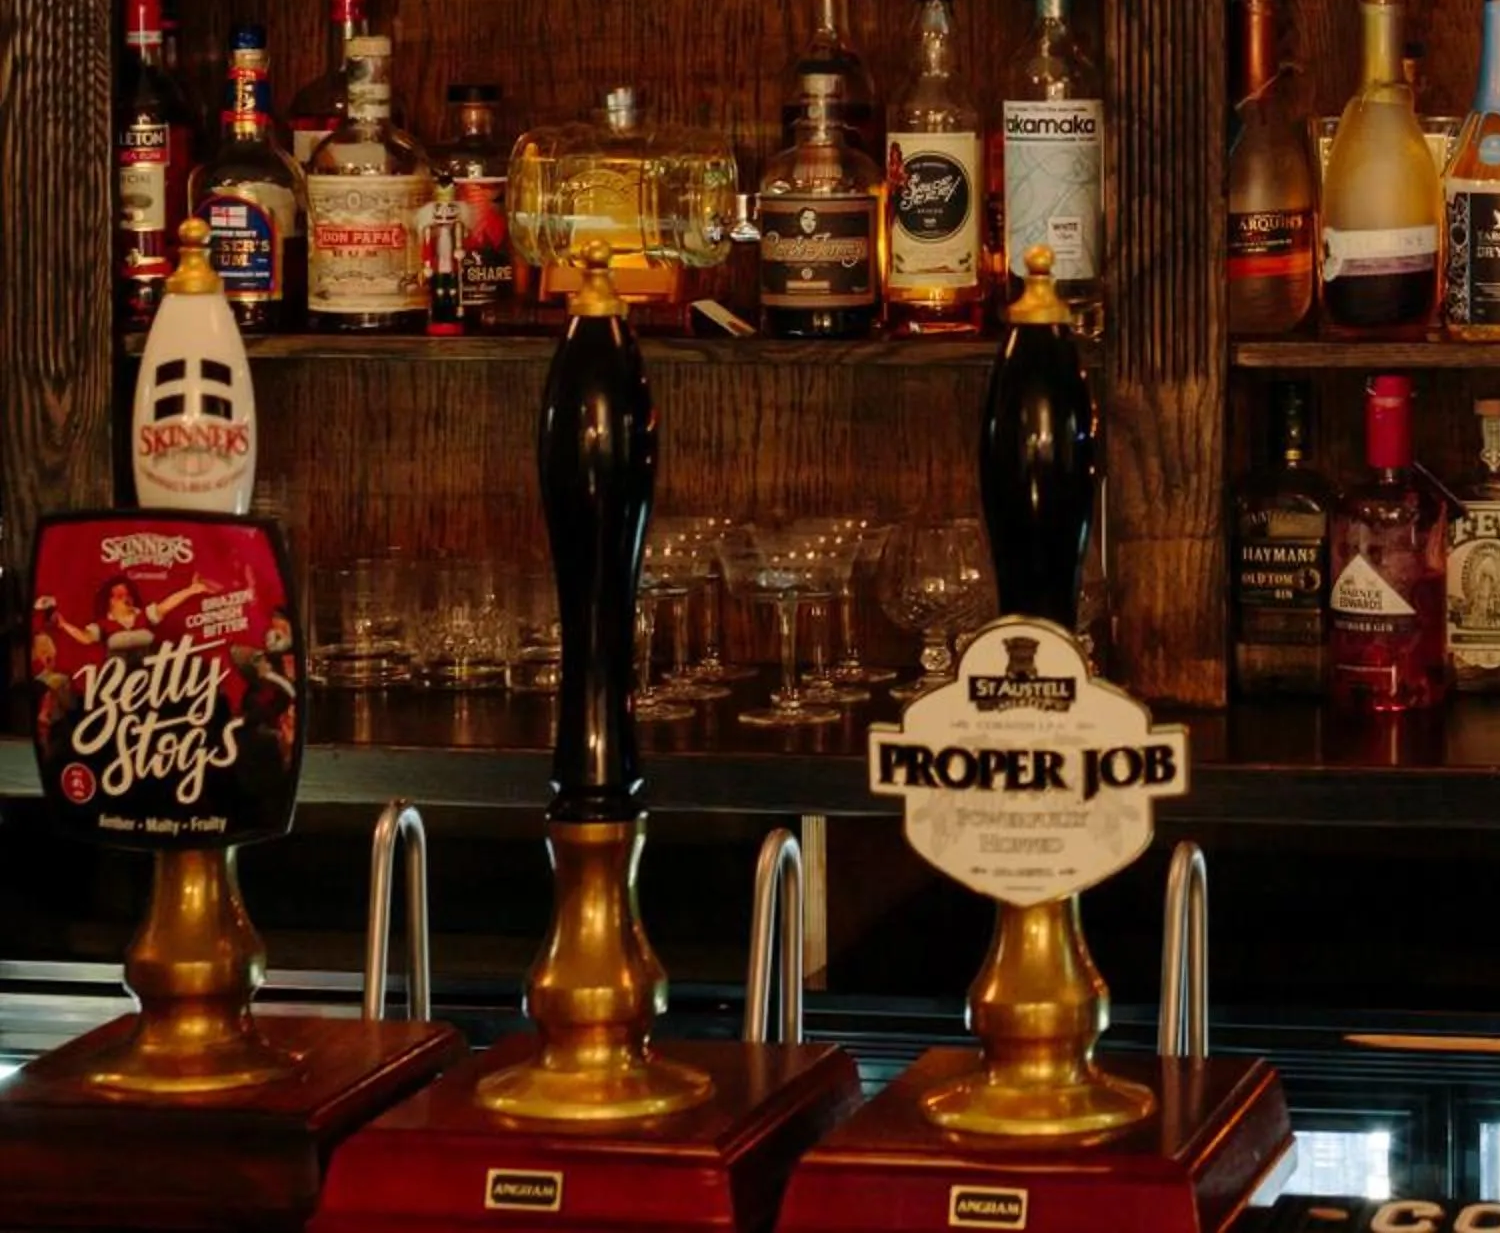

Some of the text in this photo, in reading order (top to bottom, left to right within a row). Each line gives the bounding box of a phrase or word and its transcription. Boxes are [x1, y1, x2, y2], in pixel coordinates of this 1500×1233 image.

[321, 231, 352, 246] DON
[466, 265, 513, 282] SHARE
[71, 634, 231, 755] Betty
[101, 711, 245, 805] Stogs
[879, 743, 1177, 802] PROPER JOB
